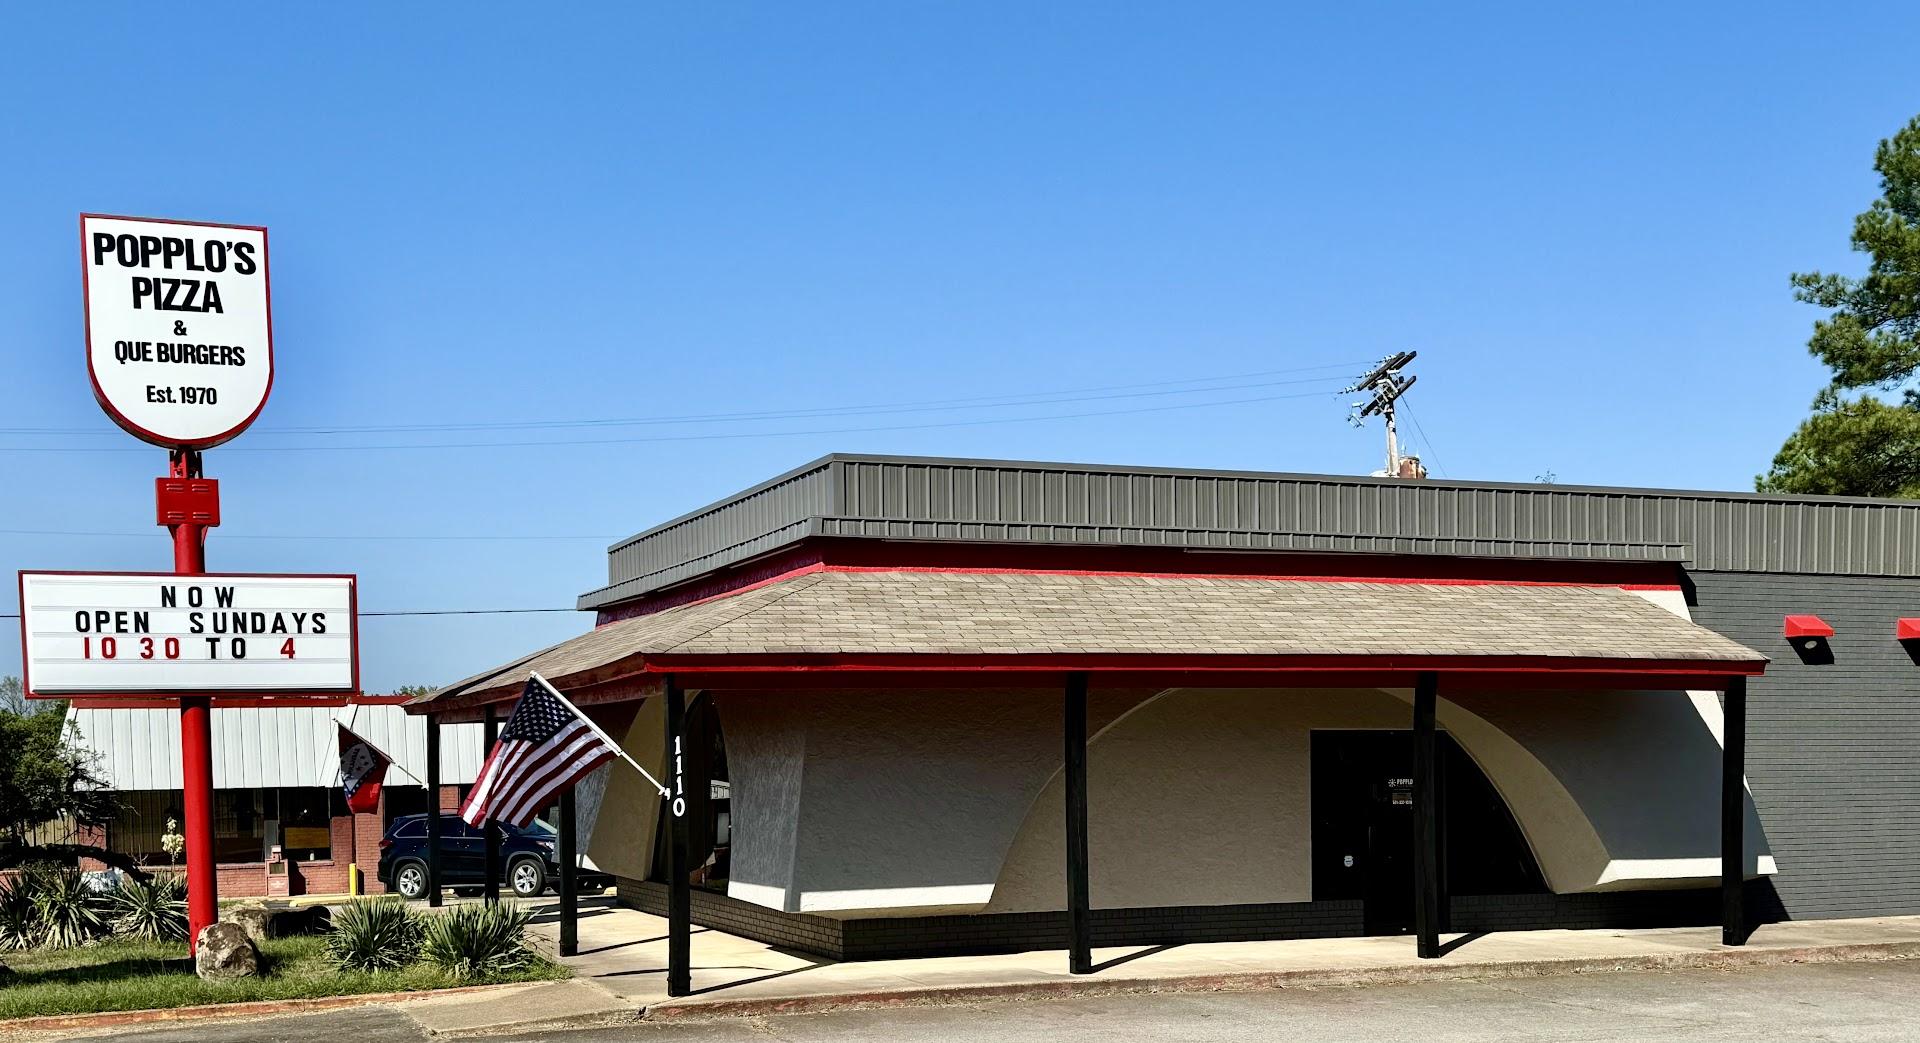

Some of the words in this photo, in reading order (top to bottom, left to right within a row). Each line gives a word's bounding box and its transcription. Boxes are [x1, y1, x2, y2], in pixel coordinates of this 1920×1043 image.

[93, 232, 257, 275] POPPLO'S
[131, 276, 224, 314] PIZZA
[173, 319, 188, 336] &
[114, 340, 154, 364] QUE
[156, 342, 246, 367] BURGERS
[146, 385, 177, 404] Est.
[179, 386, 217, 405] 1970
[161, 585, 235, 608] NOW
[75, 610, 150, 634] OPEN
[189, 611, 326, 635] SUNDAYS
[140, 637, 180, 660] 30
[205, 637, 246, 660] TO
[279, 637, 296, 660] 4
[672, 735, 686, 817] 1110
